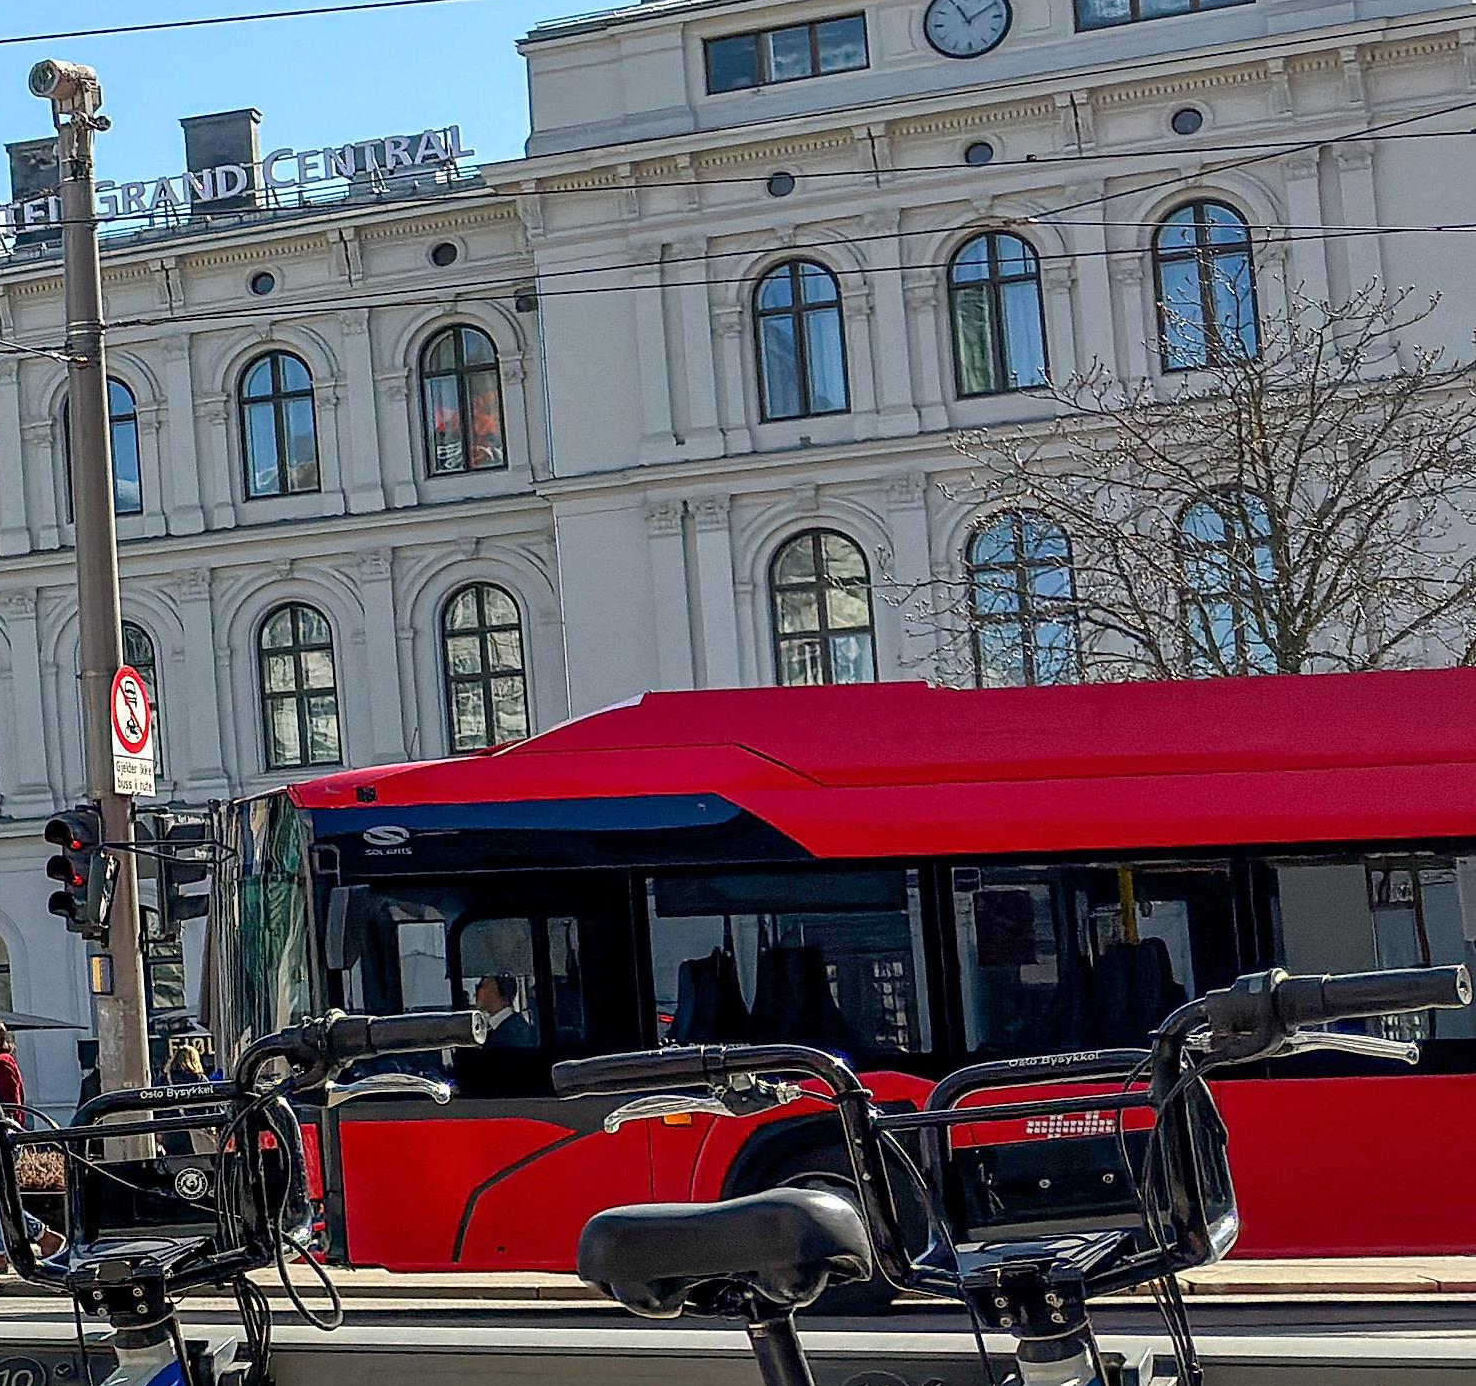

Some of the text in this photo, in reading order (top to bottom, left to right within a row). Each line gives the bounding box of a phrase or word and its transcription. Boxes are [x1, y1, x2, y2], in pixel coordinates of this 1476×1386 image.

[94, 165, 248, 216] GRAND
[117, 777, 133, 790] buss
[139, 1084, 215, 1101] Oslo Bysykkel
